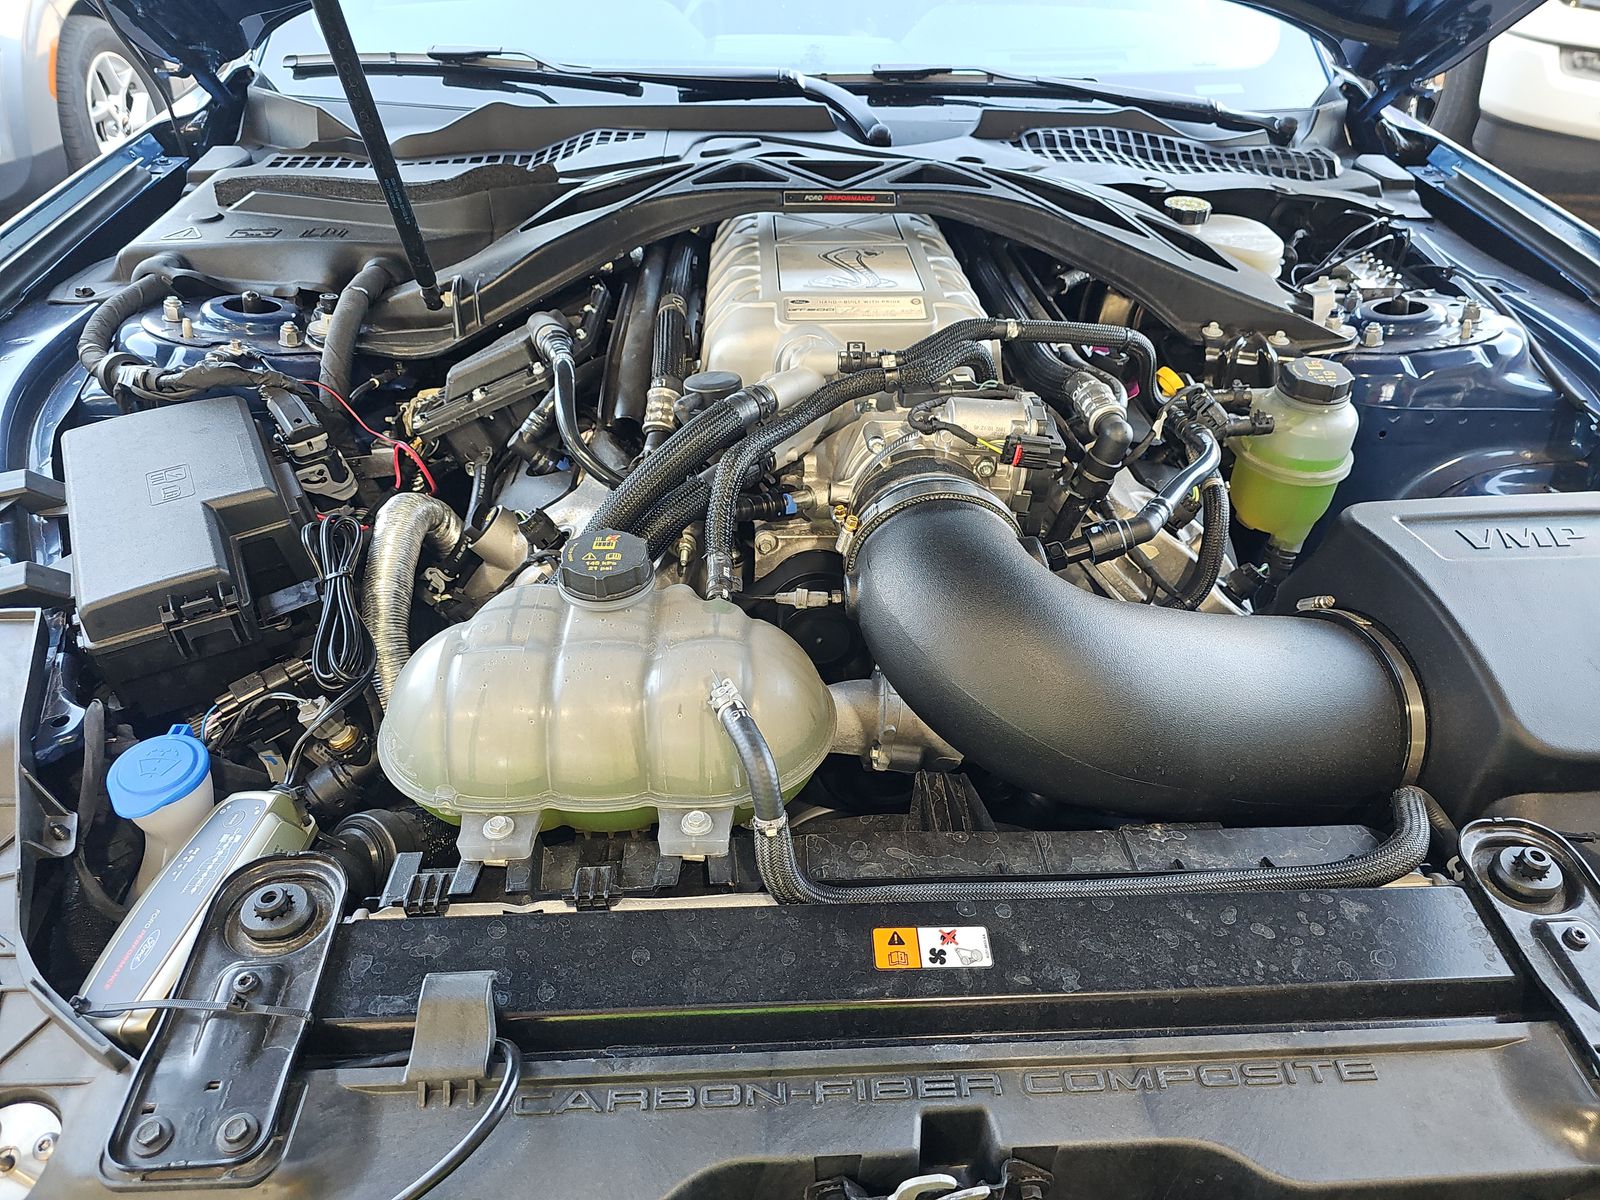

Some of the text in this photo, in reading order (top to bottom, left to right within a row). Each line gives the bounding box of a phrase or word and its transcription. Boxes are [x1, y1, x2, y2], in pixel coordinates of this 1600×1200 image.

[1454, 526, 1586, 550] VMP
[143, 908, 161, 929] FORD
[513, 1057, 1379, 1116] CARBON-FIBER COMPOSITE
